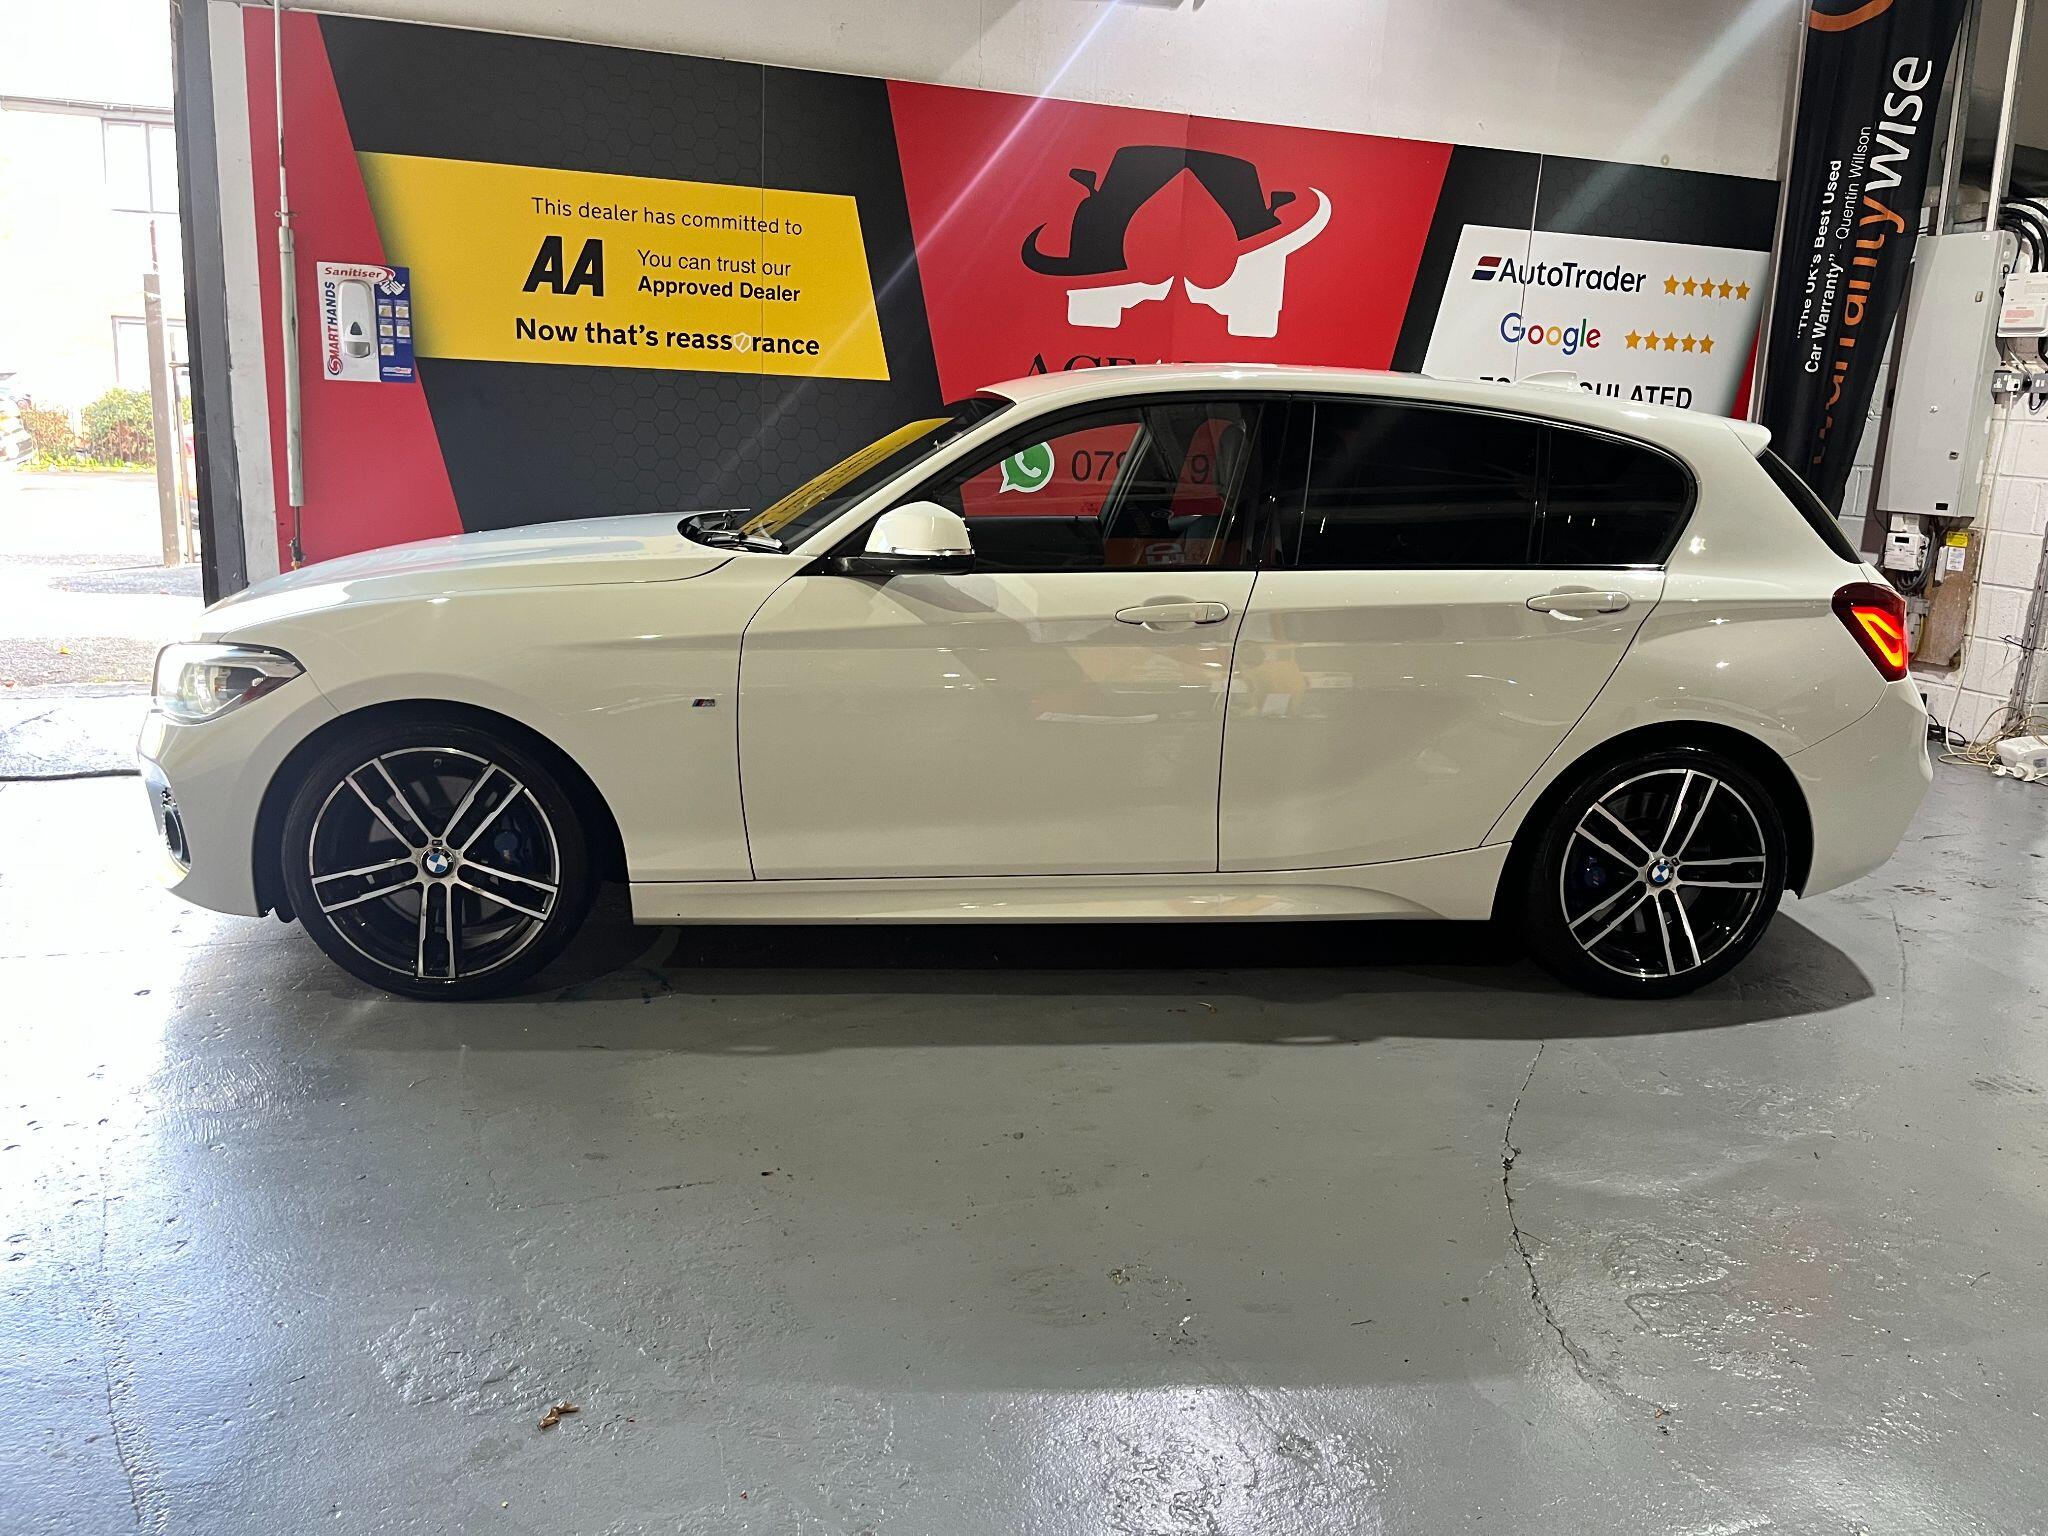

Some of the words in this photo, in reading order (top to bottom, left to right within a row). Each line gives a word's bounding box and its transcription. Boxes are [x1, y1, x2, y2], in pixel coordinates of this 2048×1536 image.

[1847, 126, 1872, 178] Willson
[1822, 160, 1842, 205] Used
[531, 197, 572, 217] This
[578, 200, 638, 223] dealer
[644, 206, 676, 226] has
[681, 213, 779, 234] committed
[784, 218, 803, 236] to
[1814, 209, 1832, 248] Best
[1835, 182, 1860, 240] Quentin
[325, 267, 382, 279] Sanitiser
[522, 235, 604, 297] AA
[637, 249, 672, 268] You
[678, 256, 711, 271] can
[716, 257, 757, 274] trust
[762, 262, 791, 277] our
[1499, 257, 1647, 293] AutoTrader
[637, 275, 733, 298] Approved
[740, 281, 801, 302] Dealer
[516, 317, 577, 341] Now
[585, 321, 659, 347] that’s
[1500, 312, 1601, 355] Google
[1804, 343, 1823, 373] Car
